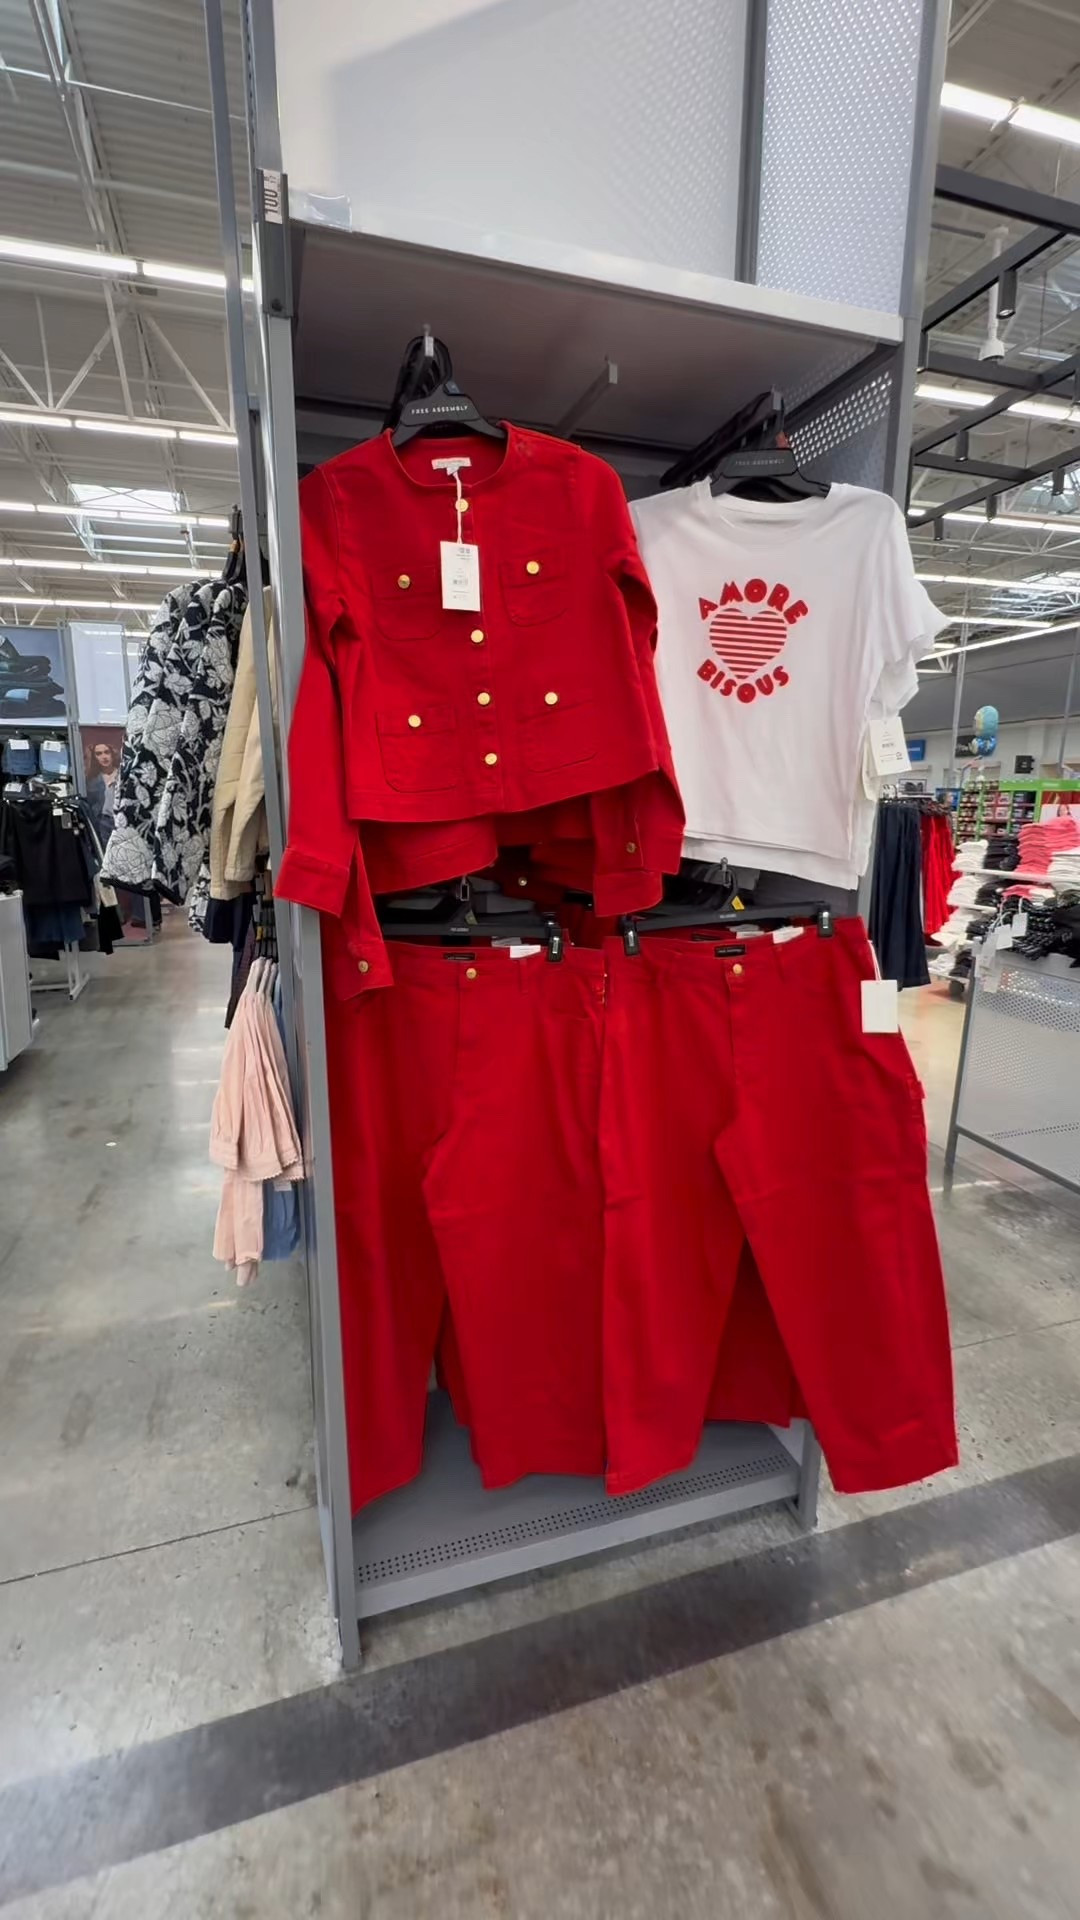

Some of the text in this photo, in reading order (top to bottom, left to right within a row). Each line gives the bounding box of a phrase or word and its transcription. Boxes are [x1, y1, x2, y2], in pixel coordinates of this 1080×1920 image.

[264, 188, 278, 214] 100
[432, 405, 468, 413] ASSEMBLY
[698, 578, 809, 625] AMORE
[697, 659, 790, 704] BISOUS
